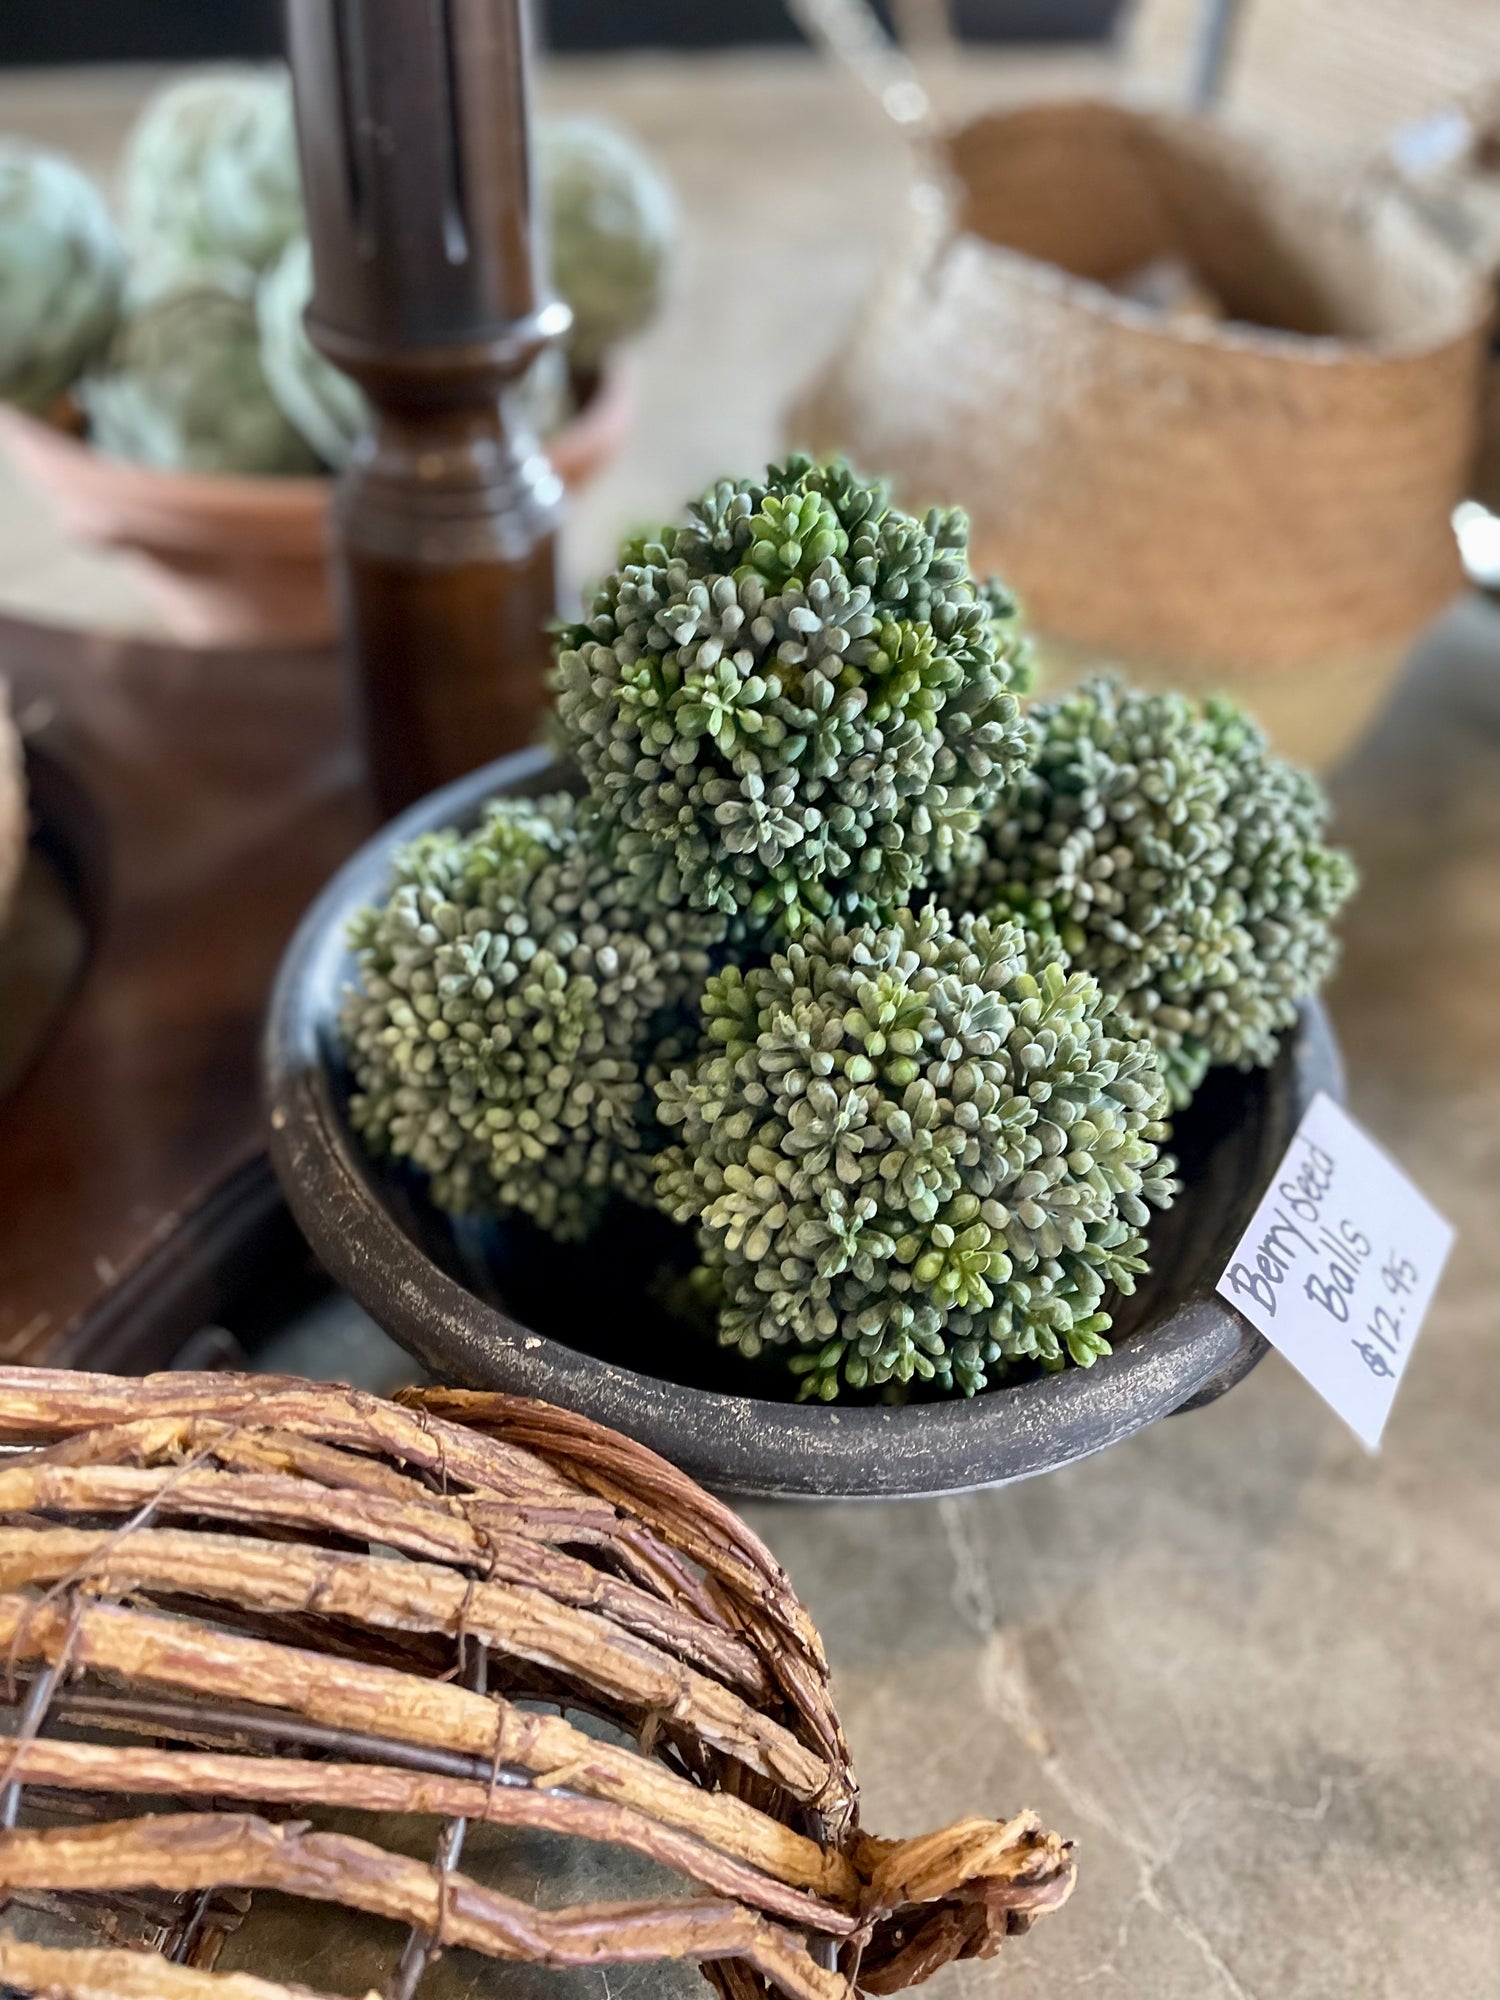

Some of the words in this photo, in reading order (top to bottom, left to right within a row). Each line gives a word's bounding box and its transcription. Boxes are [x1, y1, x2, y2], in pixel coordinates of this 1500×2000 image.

[1226, 1207, 1320, 1318] Berry
[1278, 1136, 1334, 1223] Seed
[1303, 1219, 1373, 1323] Balls
[1351, 1249, 1419, 1378] $12.95
